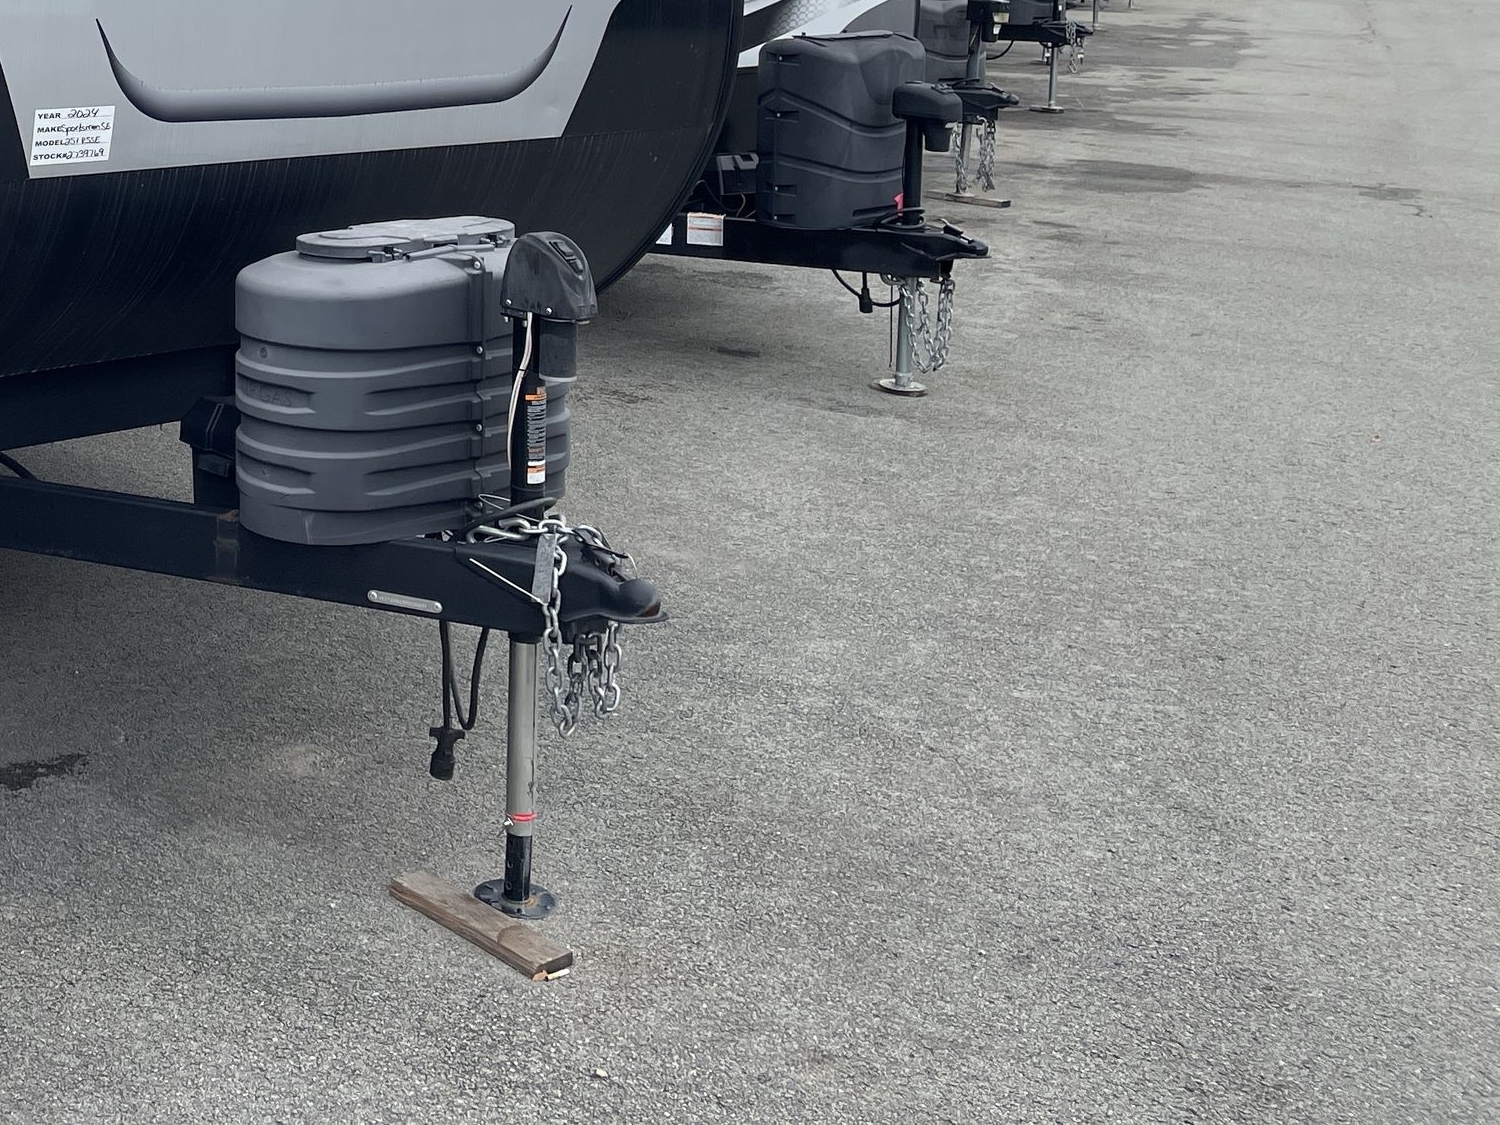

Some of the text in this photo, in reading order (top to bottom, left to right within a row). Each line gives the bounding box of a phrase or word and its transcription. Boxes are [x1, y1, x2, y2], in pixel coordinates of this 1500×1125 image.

[37, 108, 100, 120] YEAR 2024
[37, 125, 62, 133] MAKE
[35, 139, 65, 147] MODEL
[33, 152, 67, 161] STOCK#
